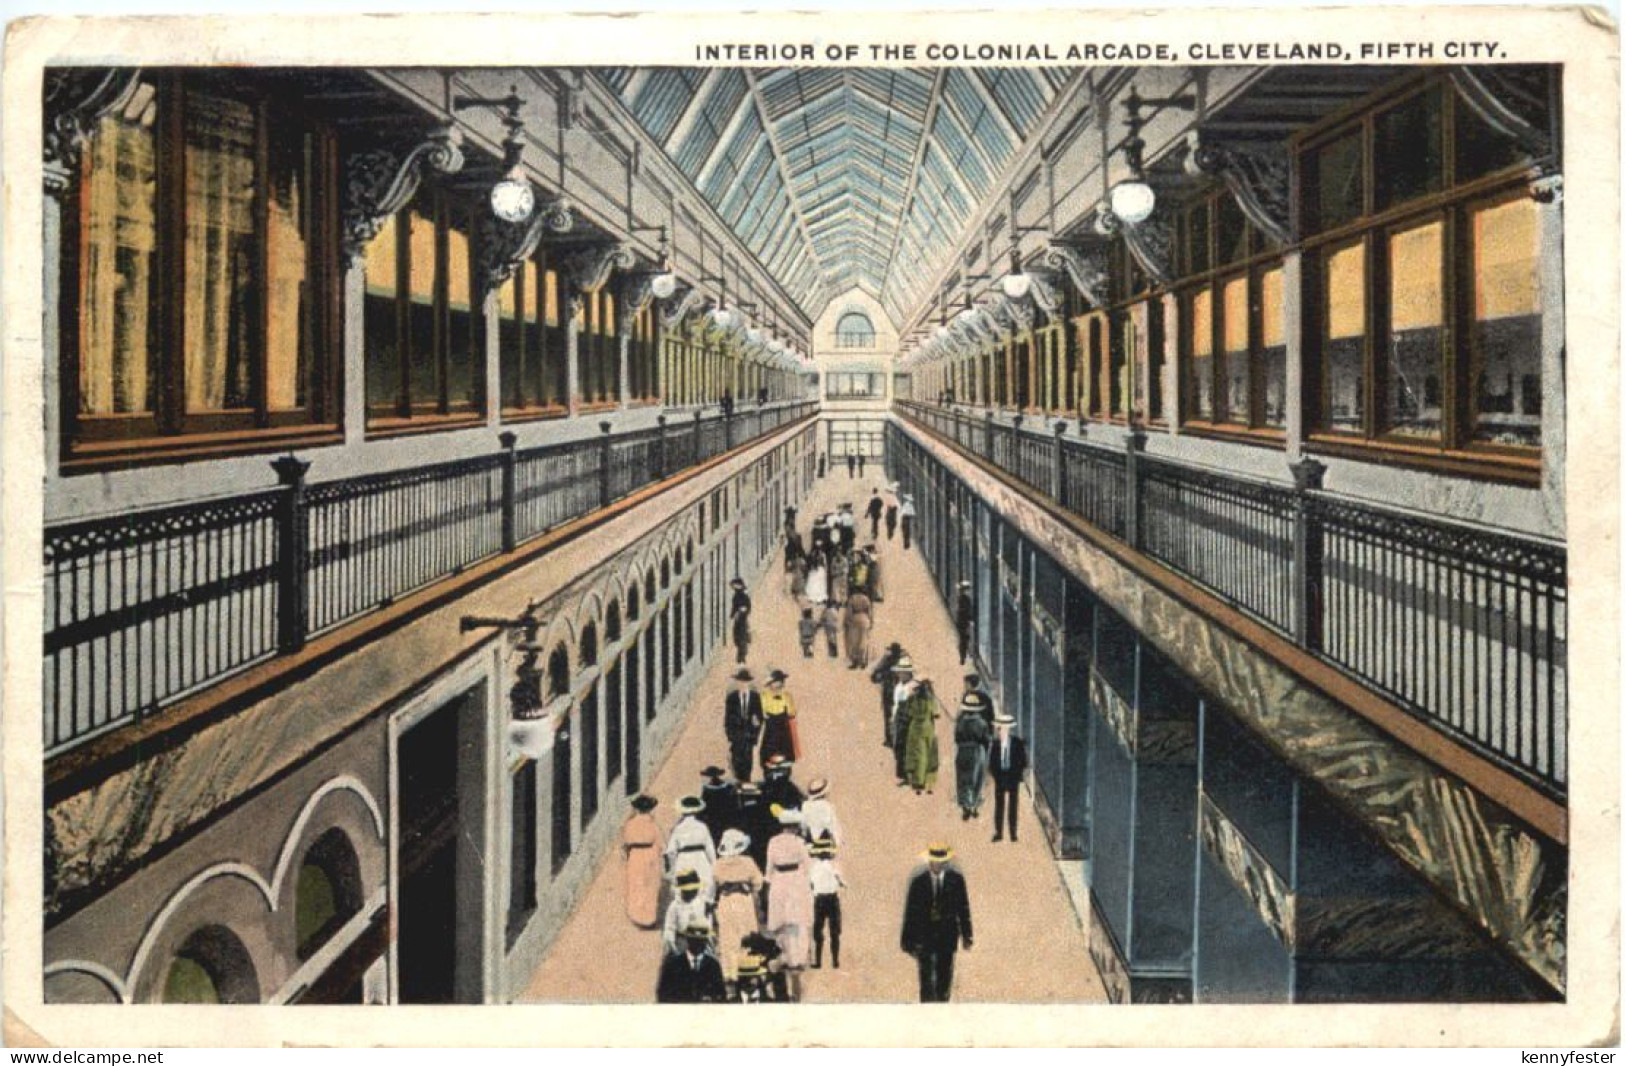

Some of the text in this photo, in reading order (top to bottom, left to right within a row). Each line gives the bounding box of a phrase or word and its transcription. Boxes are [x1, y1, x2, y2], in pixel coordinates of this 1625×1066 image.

[696, 41, 1507, 61] INTERIOR OF THE COLONIAL ARCADE, CLEVELAND, FIFTH CITY.
